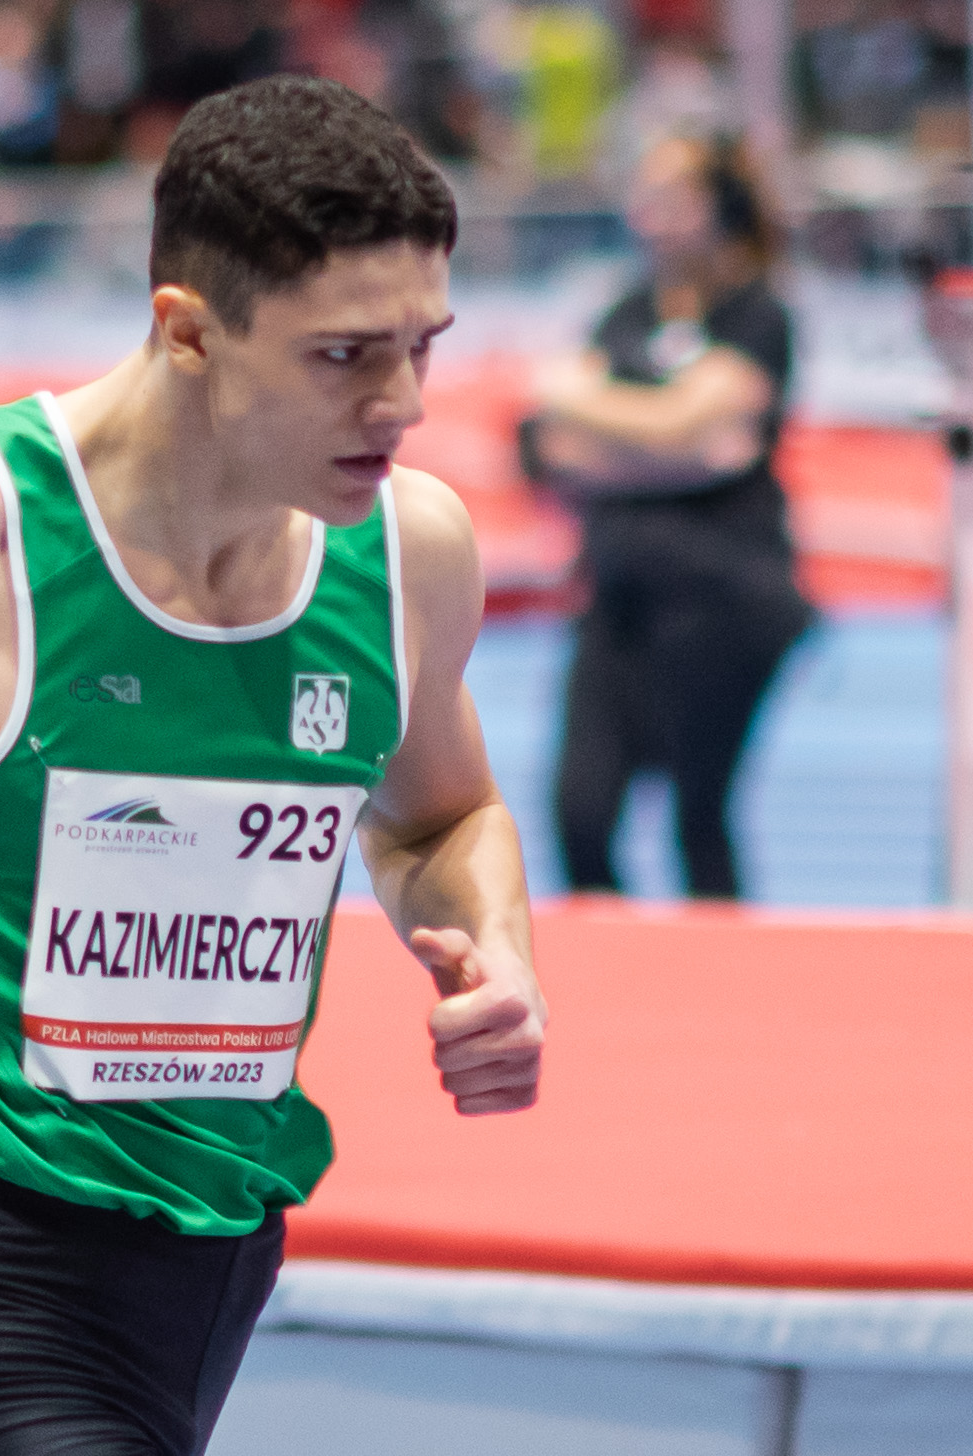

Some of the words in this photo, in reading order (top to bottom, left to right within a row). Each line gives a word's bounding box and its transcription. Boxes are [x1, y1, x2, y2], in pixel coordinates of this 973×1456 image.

[54, 823, 199, 847] PODKARPACKIE
[236, 802, 341, 863] 923
[41, 1024, 82, 1044] PZLA
[86, 1030, 139, 1046] Halowe
[142, 1031, 220, 1047] Mistrzostwa
[223, 1032, 262, 1047] Polski
[92, 1056, 207, 1084] RZESZÓW
[208, 1061, 264, 1083] 2023
